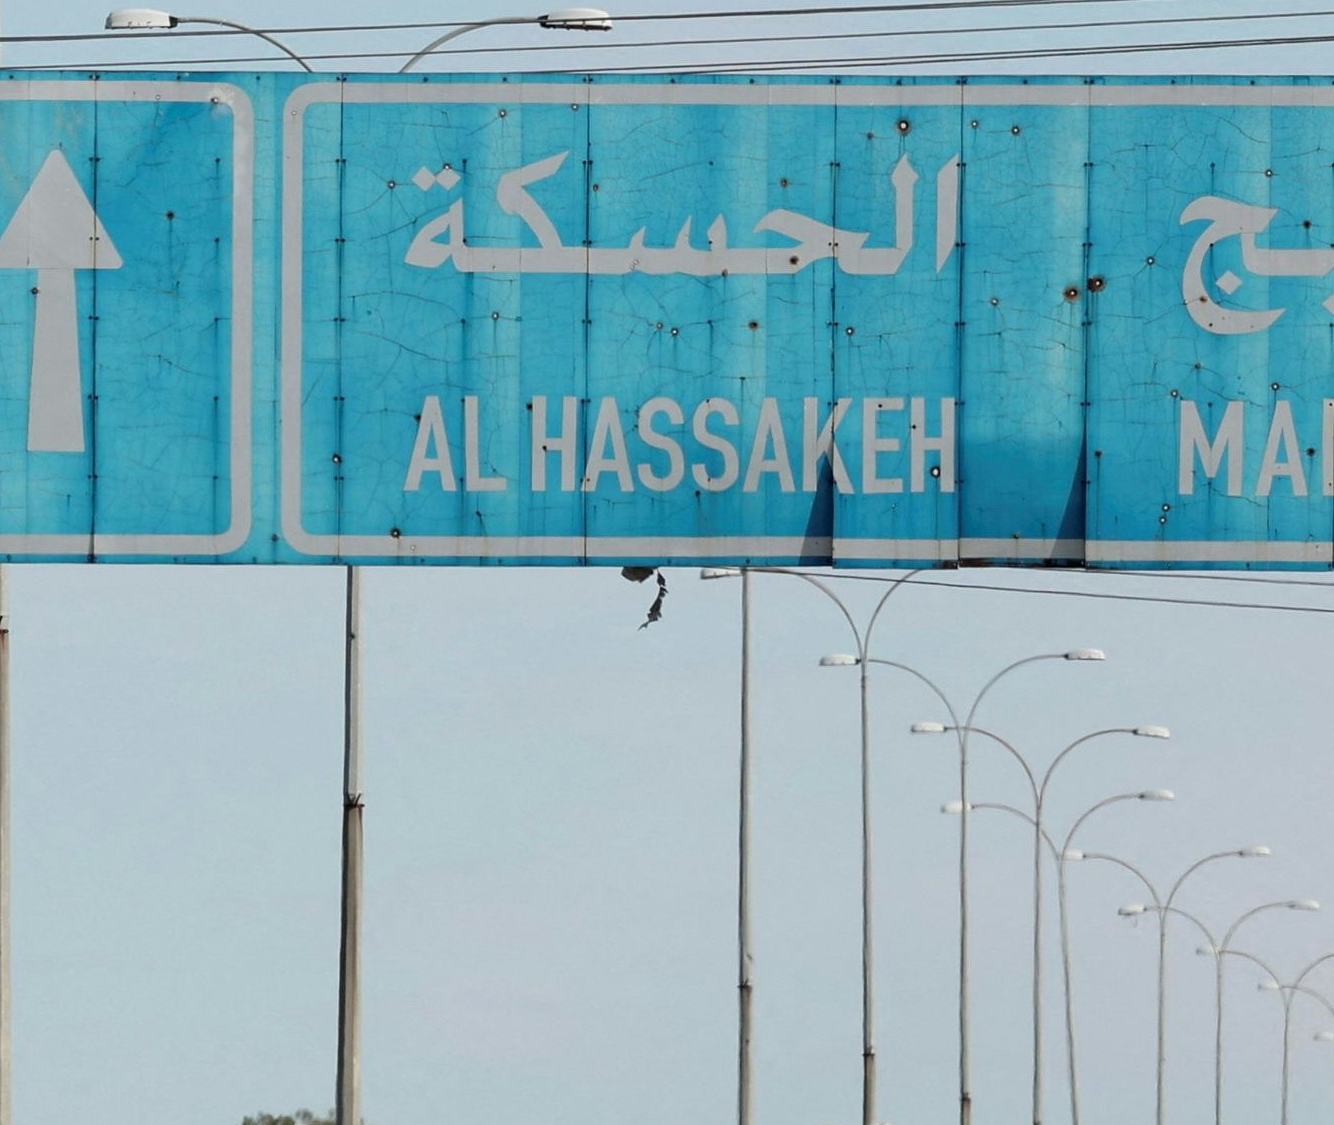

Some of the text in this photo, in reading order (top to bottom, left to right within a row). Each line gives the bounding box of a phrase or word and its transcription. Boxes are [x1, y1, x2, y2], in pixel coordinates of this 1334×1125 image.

[404, 150, 960, 276] الحسكة
[404, 395, 956, 494] AL HASSAKEH
